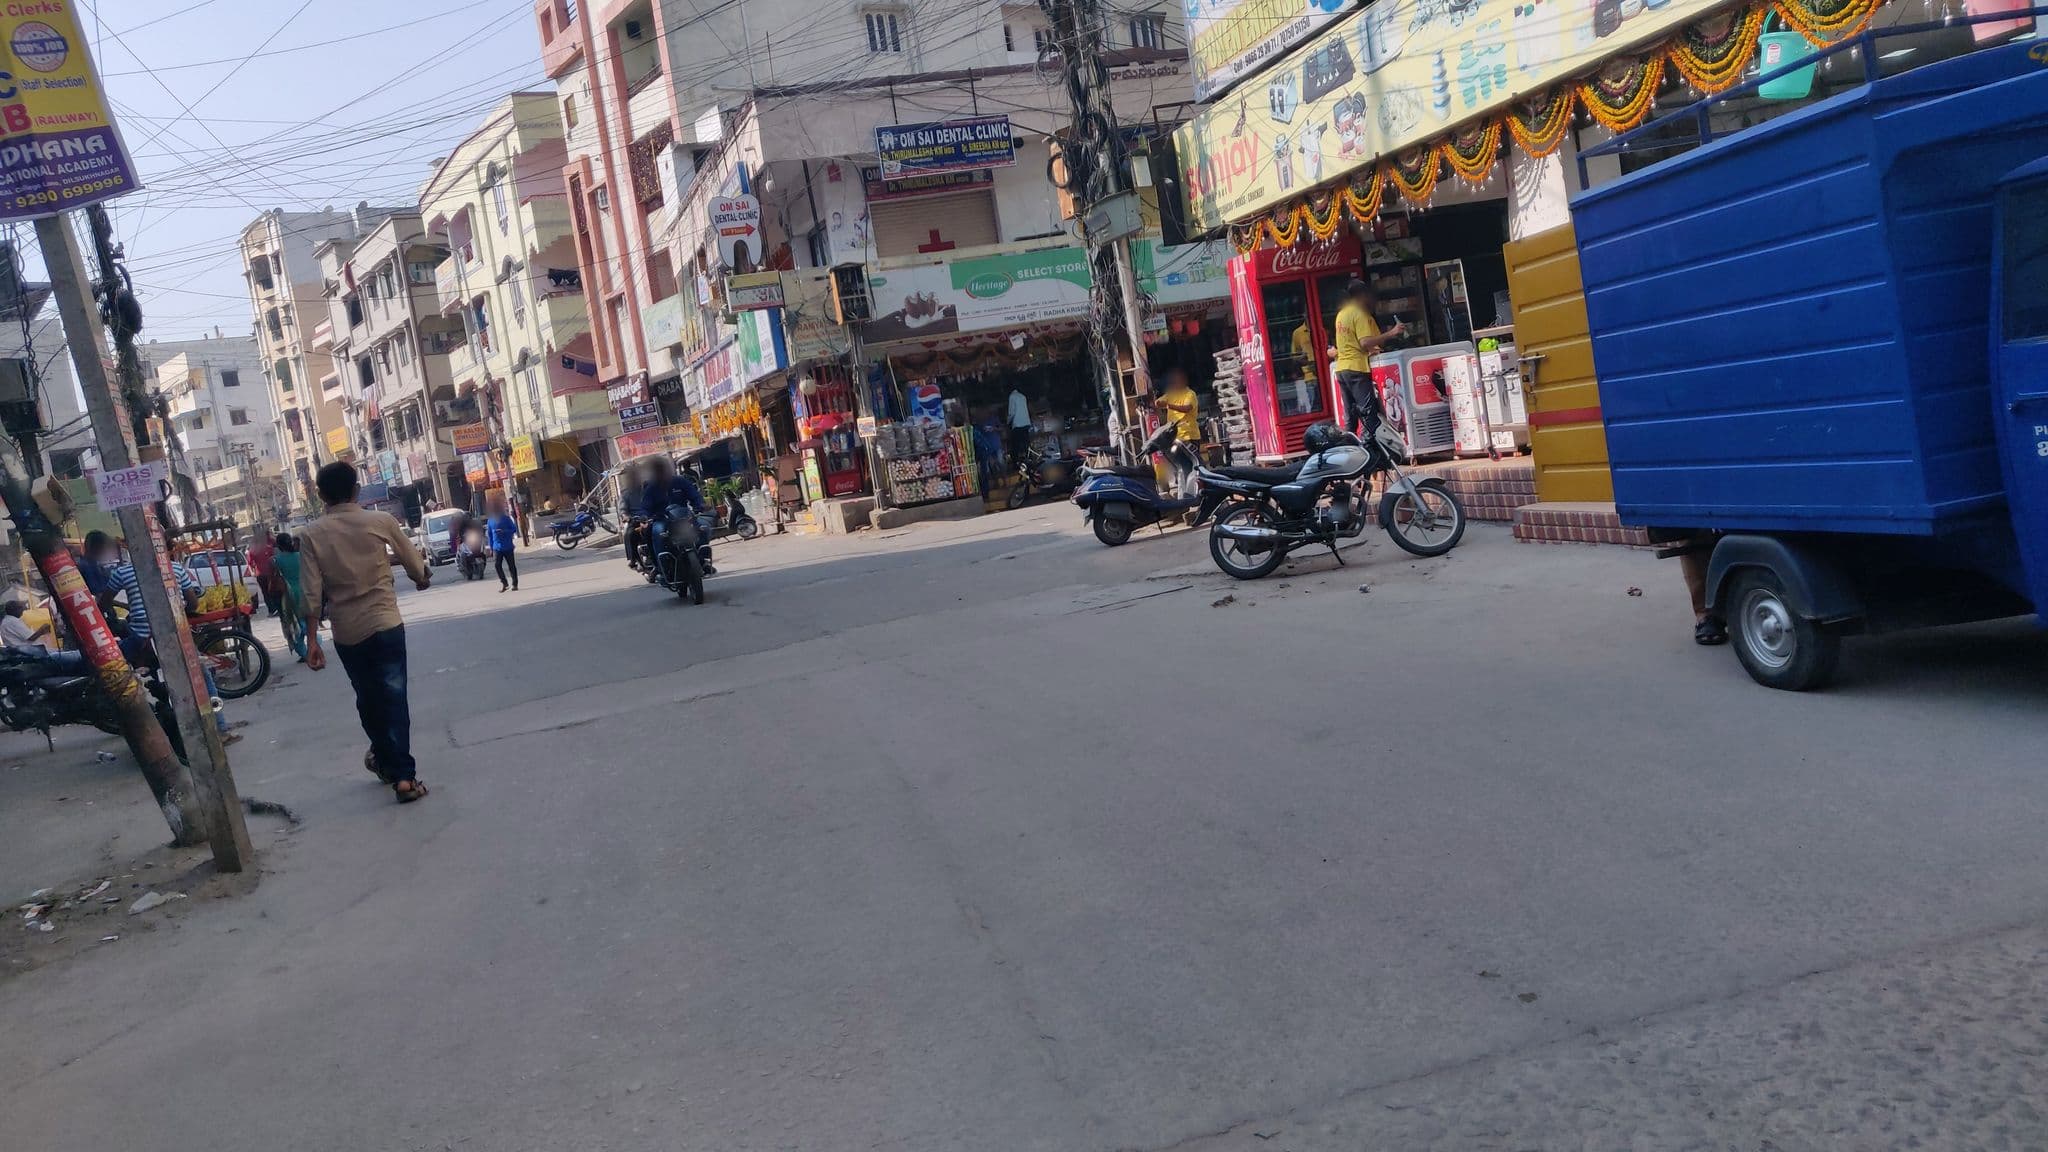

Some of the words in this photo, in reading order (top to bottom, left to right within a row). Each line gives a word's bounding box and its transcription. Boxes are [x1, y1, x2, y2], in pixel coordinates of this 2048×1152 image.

[7, 1, 63, 17] Clerks
[0, 102, 33, 136] B
[35, 112, 98, 127] (RAILWAY)
[900, 132, 916, 148] OM
[918, 131, 934, 146] SAI
[937, 126, 975, 143] DENTAL
[976, 122, 1009, 138] CLINIC
[0, 134, 107, 169] DHANA
[57, 154, 115, 175] ACADEMY
[15, 190, 59, 208] 9290
[62, 175, 124, 199] 699996
[720, 202, 734, 212] OM
[735, 201, 750, 211] SAI
[714, 213, 737, 224] DENTAL
[738, 211, 758, 220] CLINIC
[1017, 265, 1054, 280] SELECT
[1043, 307, 1065, 318] RADHA
[102, 468, 151, 486] JOBS
